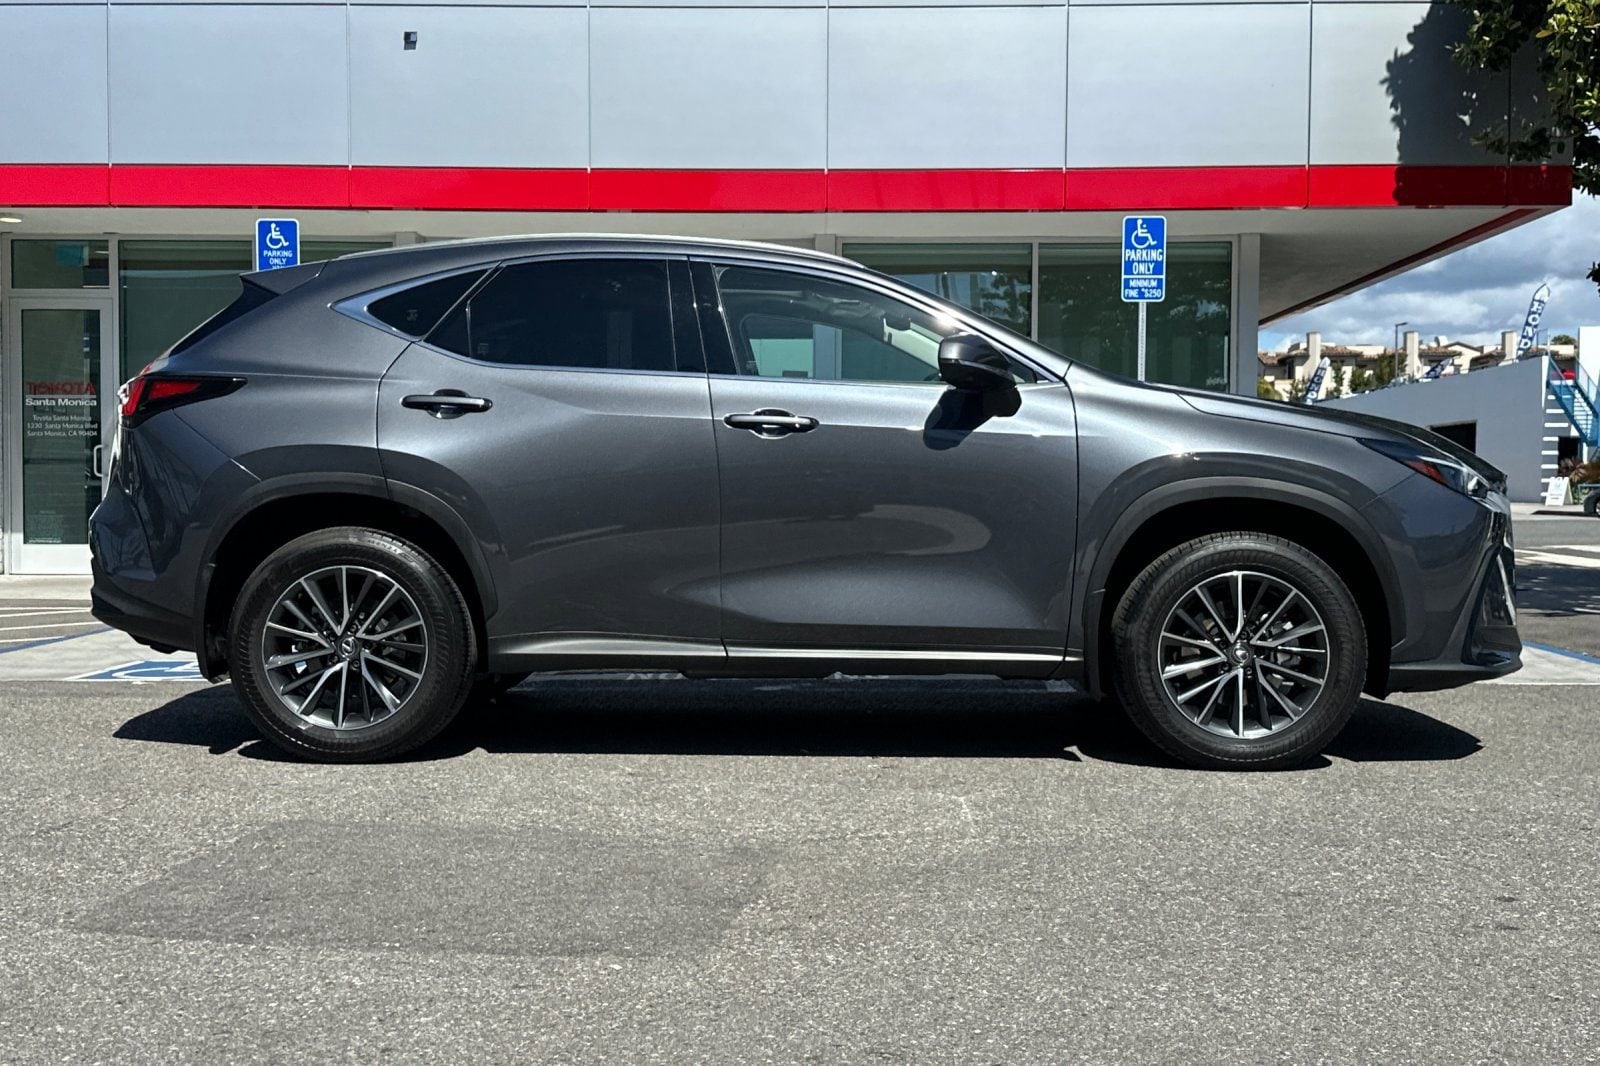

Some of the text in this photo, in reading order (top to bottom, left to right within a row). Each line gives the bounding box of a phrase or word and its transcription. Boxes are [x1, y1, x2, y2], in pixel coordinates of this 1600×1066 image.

[1125, 249, 1163, 261] PARKING
[1132, 262, 1155, 274] ONLY
[1129, 279, 1158, 288] MINIMUM
[1125, 288, 1162, 298] FINE $250
[27, 382, 97, 395] TOYOTA
